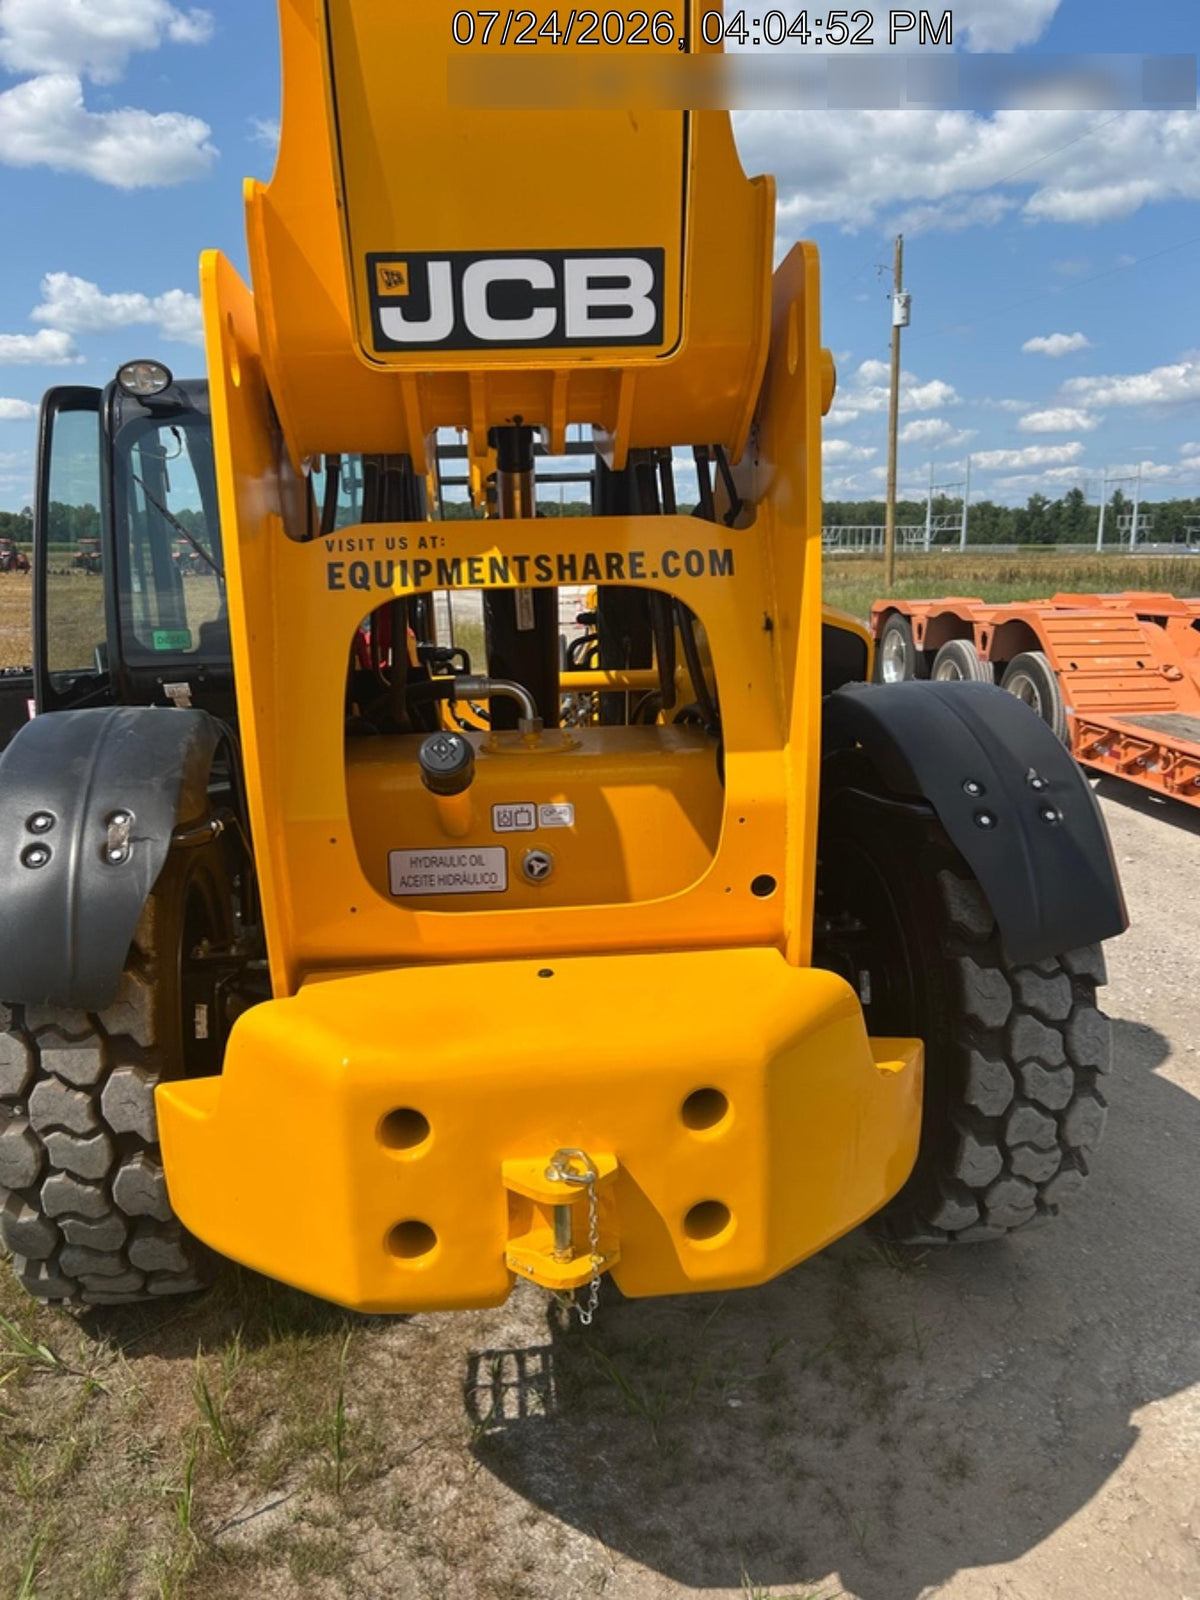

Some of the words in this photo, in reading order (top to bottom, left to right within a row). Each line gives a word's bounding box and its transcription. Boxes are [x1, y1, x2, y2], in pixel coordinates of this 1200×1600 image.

[379, 256, 657, 343] JCB
[325, 538, 375, 552] VISIT
[386, 537, 409, 550] US
[418, 536, 445, 549] AT:
[328, 549, 734, 590] EQUIPMENTSHARE.COM
[409, 855, 468, 868] HYDRAULIC
[469, 854, 486, 867] OIL
[400, 874, 436, 888] ACEITE
